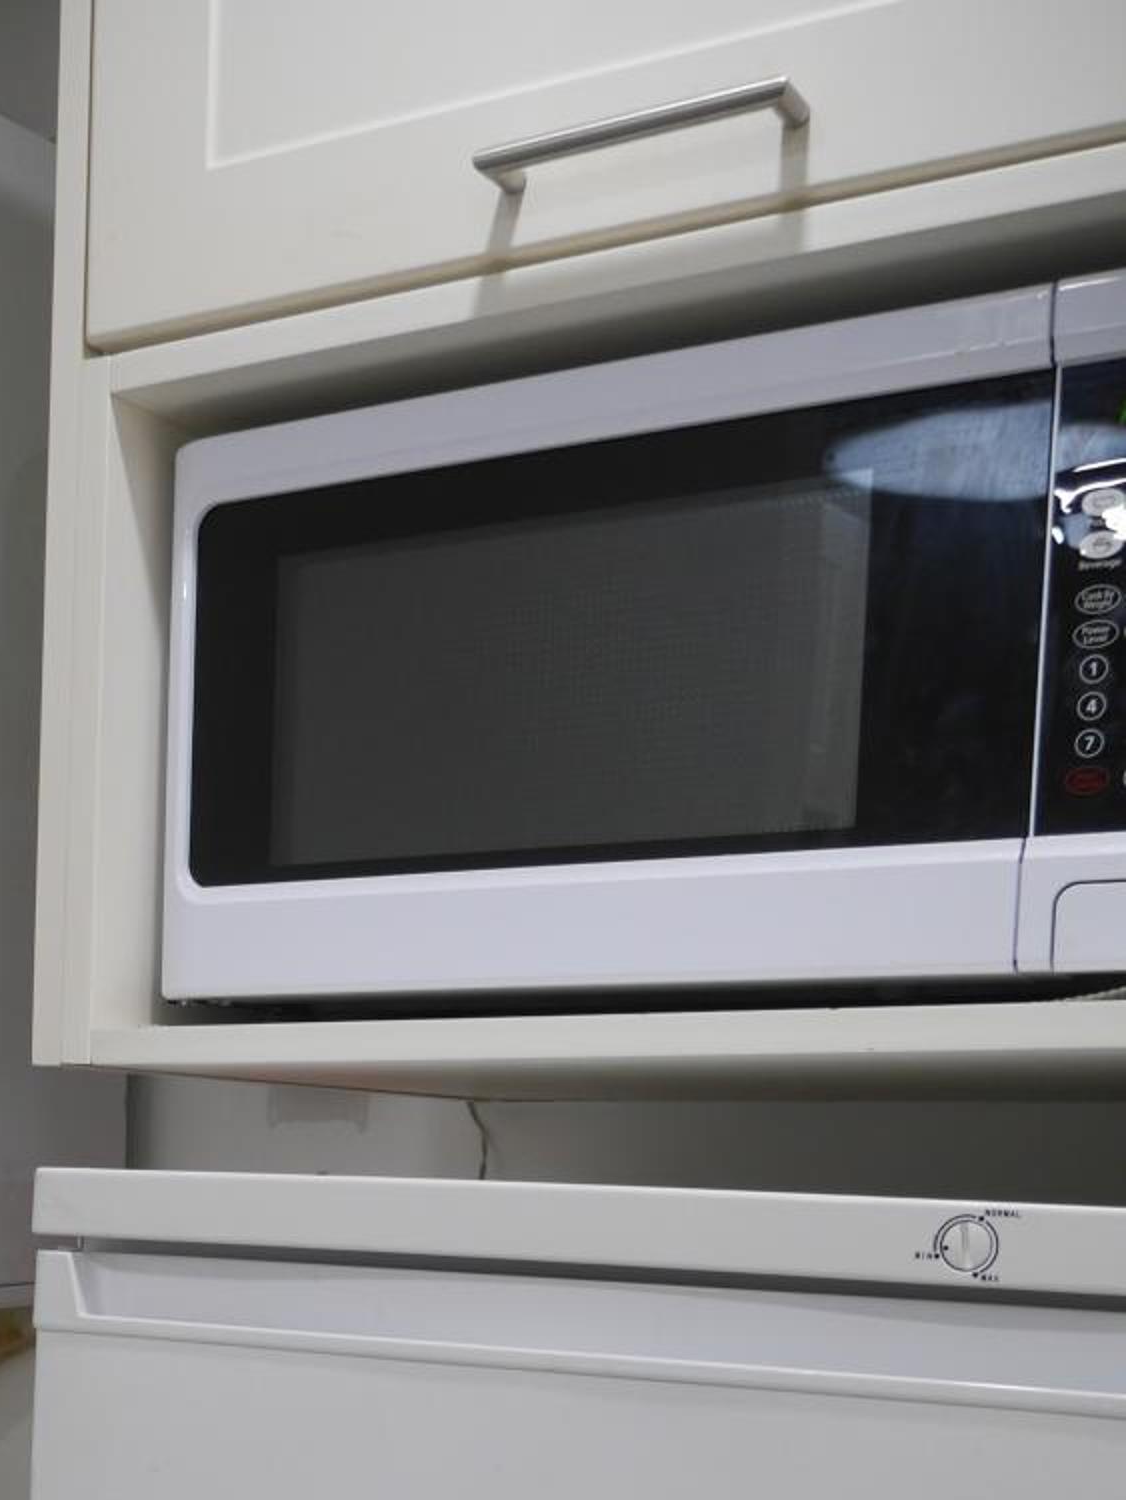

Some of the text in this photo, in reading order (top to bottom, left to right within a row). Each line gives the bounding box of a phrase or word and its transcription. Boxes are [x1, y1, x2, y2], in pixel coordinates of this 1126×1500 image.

[1089, 661, 1097, 676] 1
[1085, 699, 1097, 713] 4
[1084, 736, 1095, 751] 7
